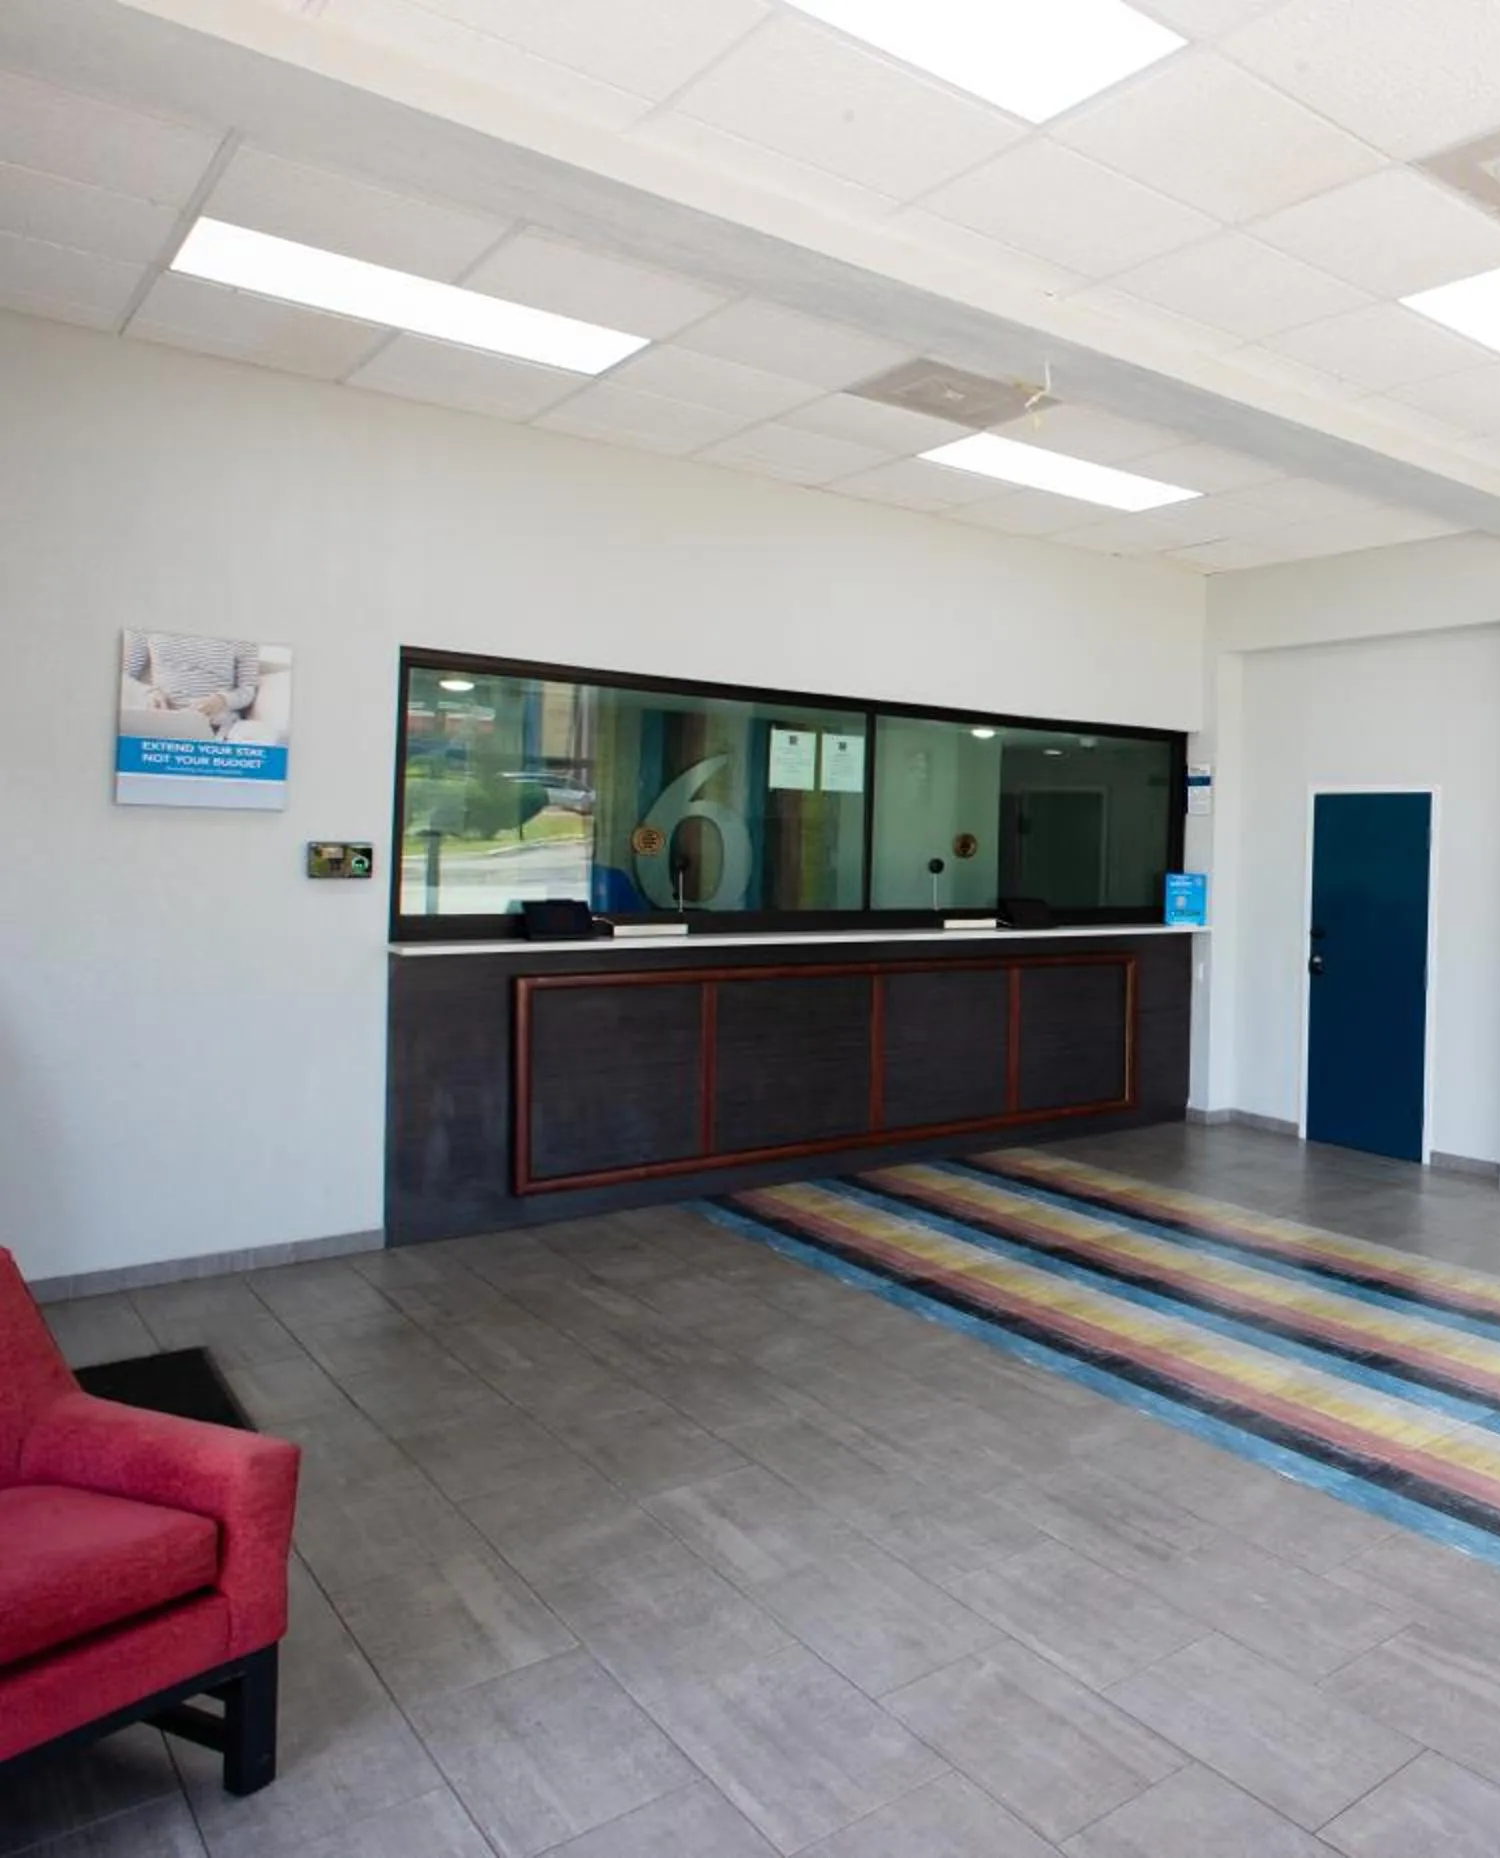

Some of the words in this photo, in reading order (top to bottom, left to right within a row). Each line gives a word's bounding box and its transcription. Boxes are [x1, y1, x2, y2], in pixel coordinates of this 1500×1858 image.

[142, 741, 194, 753] EXTEND
[198, 744, 234, 756] YOUR
[142, 753, 171, 763] NOT
[176, 755, 210, 766] YOUR
[213, 757, 263, 769] BUDGET
[633, 752, 751, 910] 6
